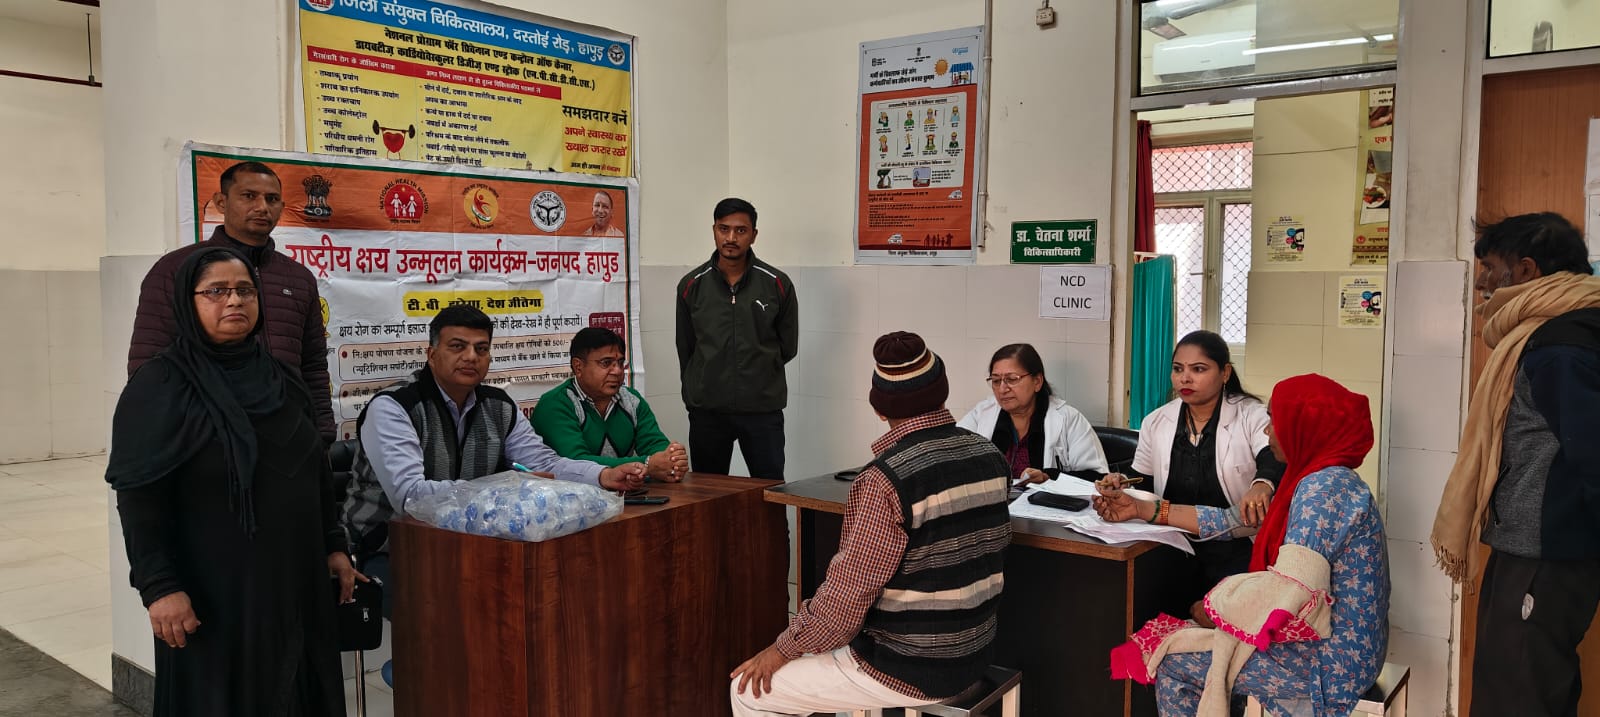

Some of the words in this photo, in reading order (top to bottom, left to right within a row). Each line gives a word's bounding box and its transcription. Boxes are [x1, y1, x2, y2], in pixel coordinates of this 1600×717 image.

[382, 1, 427, 25] संयुक्त
[430, 6, 509, 40] चिकित्सालय,
[384, 27, 413, 42] नेशनल
[562, 105, 611, 123] समझदार
[564, 126, 586, 137] अपने
[614, 133, 627, 142] का
[379, 181, 395, 210] NATIONAL
[395, 178, 418, 188] HEALTH
[417, 187, 429, 214] MISSION
[1015, 230, 1030, 242] डा.
[1035, 226, 1065, 242] चेतना
[1066, 225, 1092, 242] शर्मा
[286, 234, 352, 278] राष्ट्रीय
[355, 247, 391, 274] क्षय
[396, 249, 463, 284] उन्मूलन
[467, 238, 581, 274] कार्यक्रम-जनपद
[1023, 246, 1082, 257] चिकित्साधिकारी
[1060, 275, 1086, 287] NCD
[486, 297, 506, 309] देश
[508, 297, 542, 308] जीतेगा
[1053, 296, 1093, 309] CLINIC
[339, 326, 353, 338] क्षय
[354, 322, 369, 336] रोग
[371, 325, 382, 336] का
[383, 321, 406, 338] सम्पूर्ण
[407, 323, 427, 334] इलाज
[499, 316, 510, 330] की
[510, 316, 537, 329] देख-रेख
[544, 314, 551, 328] ही
[552, 315, 563, 330] पूर्ण
[376, 347, 394, 358] पोषण
[415, 345, 423, 356] के
